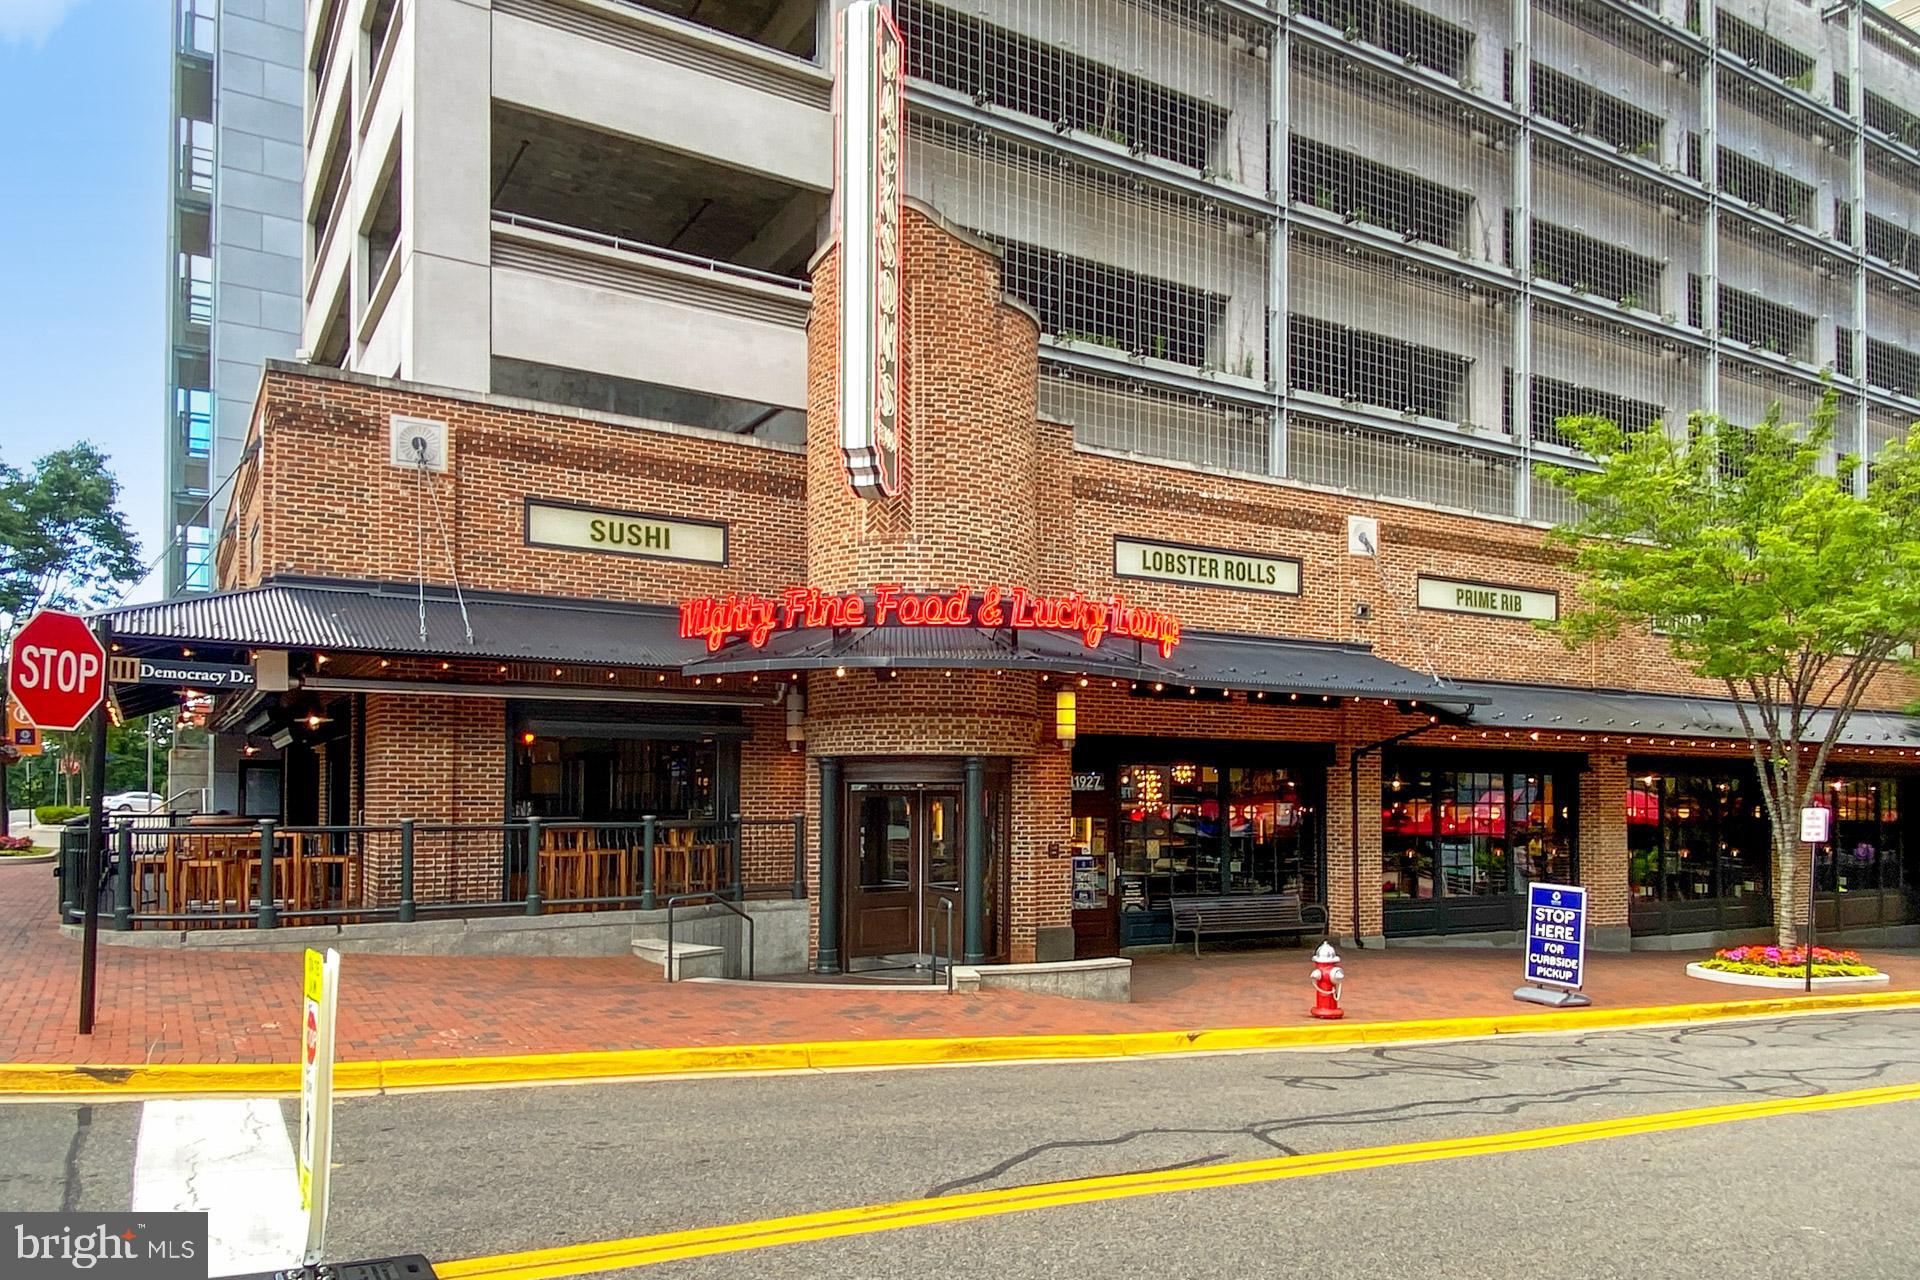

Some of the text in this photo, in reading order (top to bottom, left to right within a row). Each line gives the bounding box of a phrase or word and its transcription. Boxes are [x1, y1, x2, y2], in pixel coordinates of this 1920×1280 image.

[590, 519, 670, 550] SUSHI
[1142, 550, 1276, 585] LOBSTER ROLLS
[1456, 588, 1522, 612] PRIME RIB
[679, 594, 776, 653] Mighty
[785, 585, 866, 628] Fine
[874, 584, 972, 628] Food
[978, 584, 1004, 627] &
[1010, 585, 1109, 650] Lucky
[19, 644, 98, 694] STOP
[140, 664, 254, 685] Democracy Dr.
[1535, 907, 1576, 924] STOP
[1535, 923, 1575, 941] HERE
[1544, 942, 1565, 955] FOR
[1530, 953, 1579, 969] CURBSIDE
[1536, 967, 1573, 980] PICKUP
